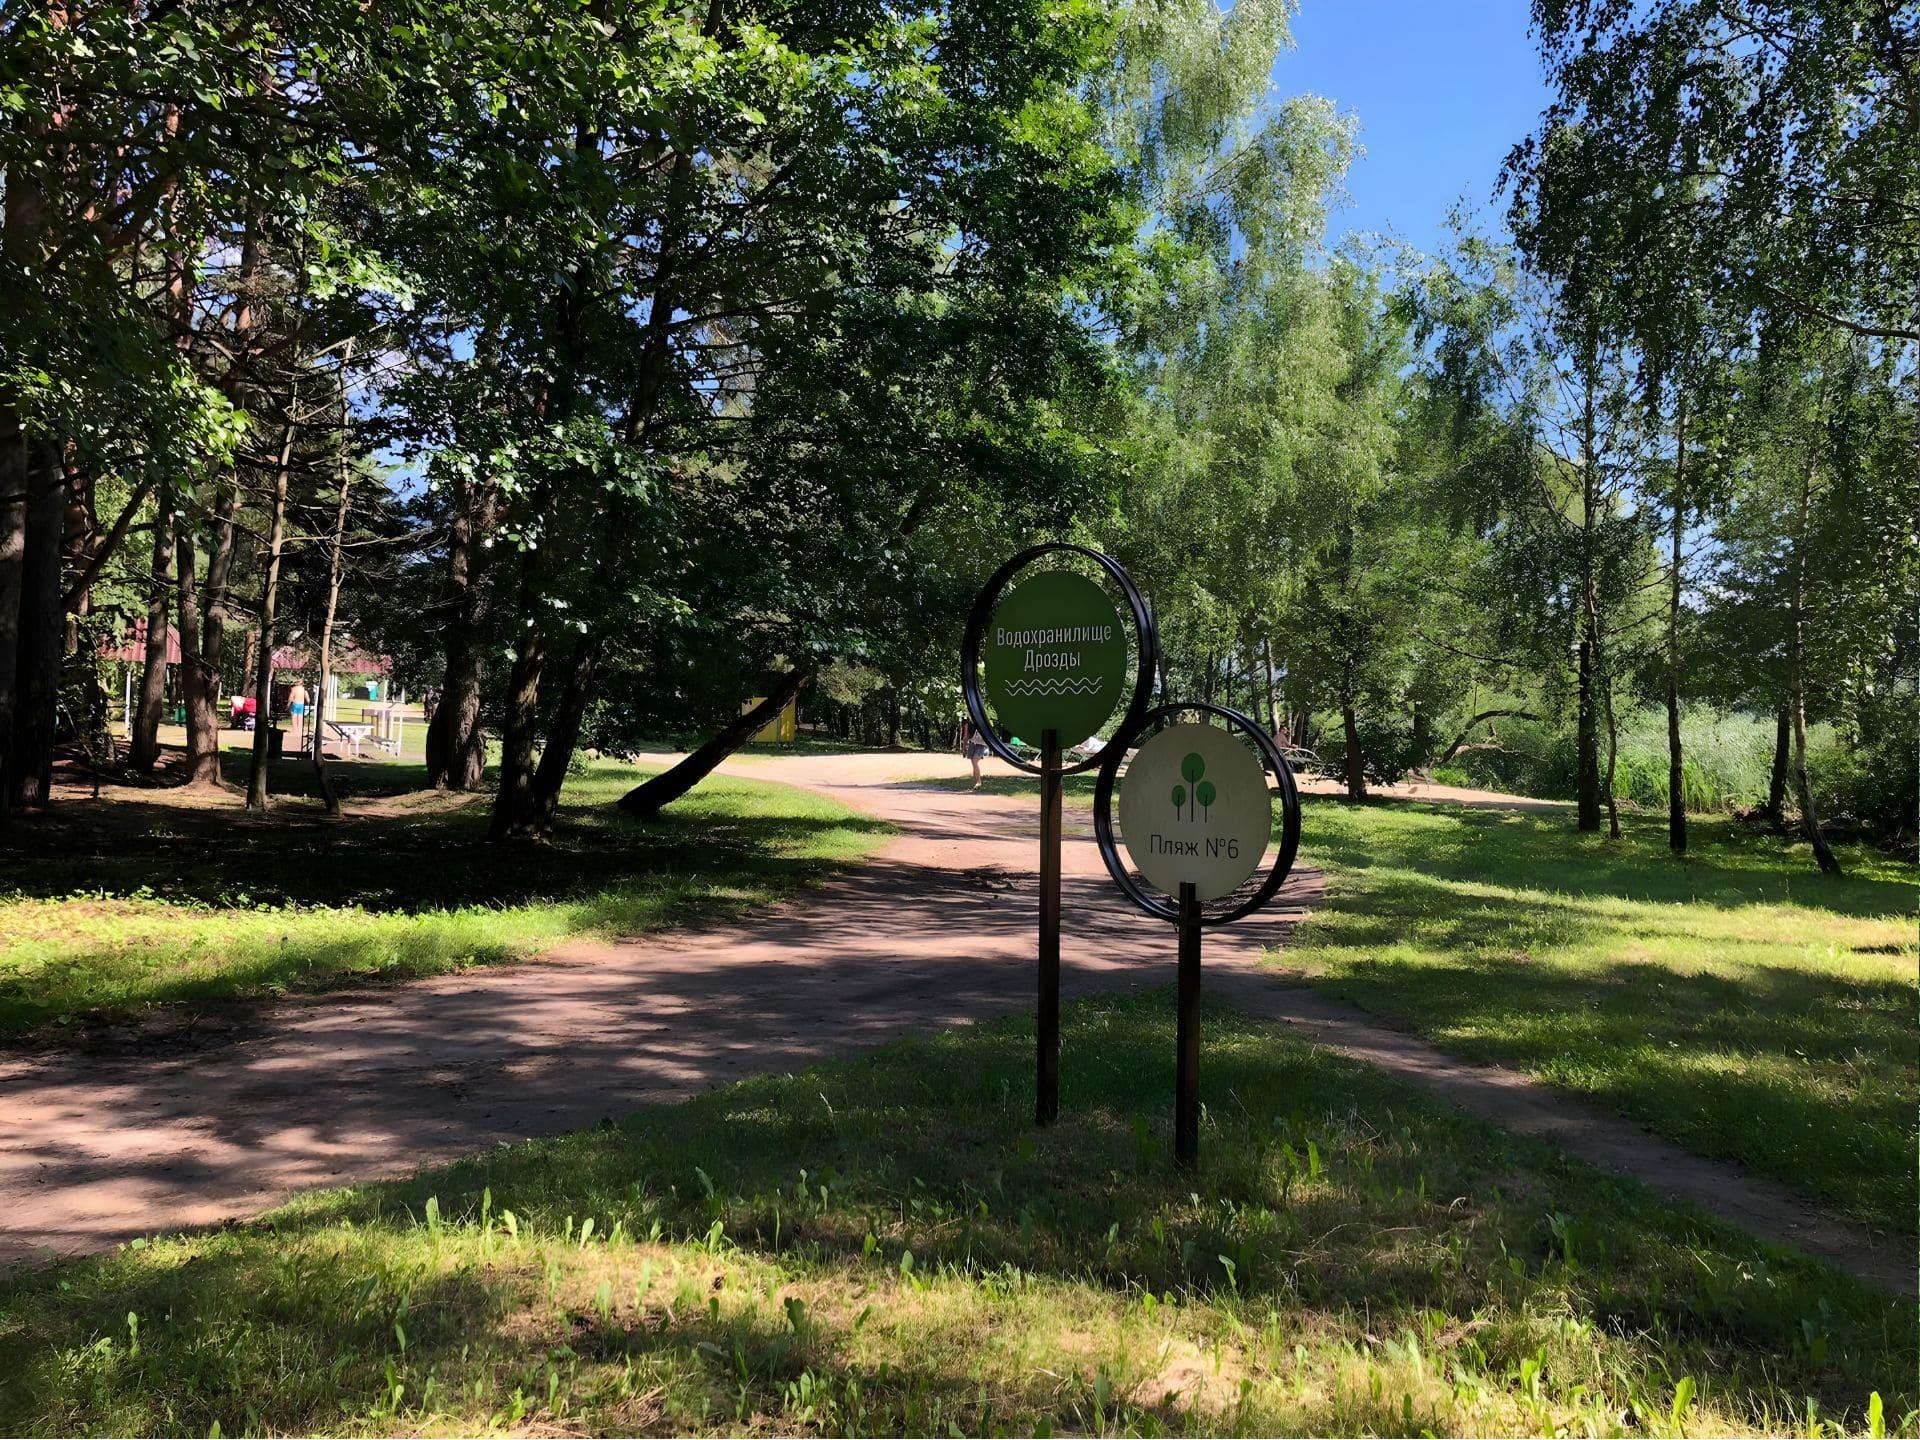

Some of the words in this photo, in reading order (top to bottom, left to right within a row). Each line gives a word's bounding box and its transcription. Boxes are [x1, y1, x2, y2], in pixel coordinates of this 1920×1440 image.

[997, 625, 1112, 648] Водохранилище
[1024, 650, 1081, 672] Дрозды
[1150, 834, 1199, 857] Пляж
